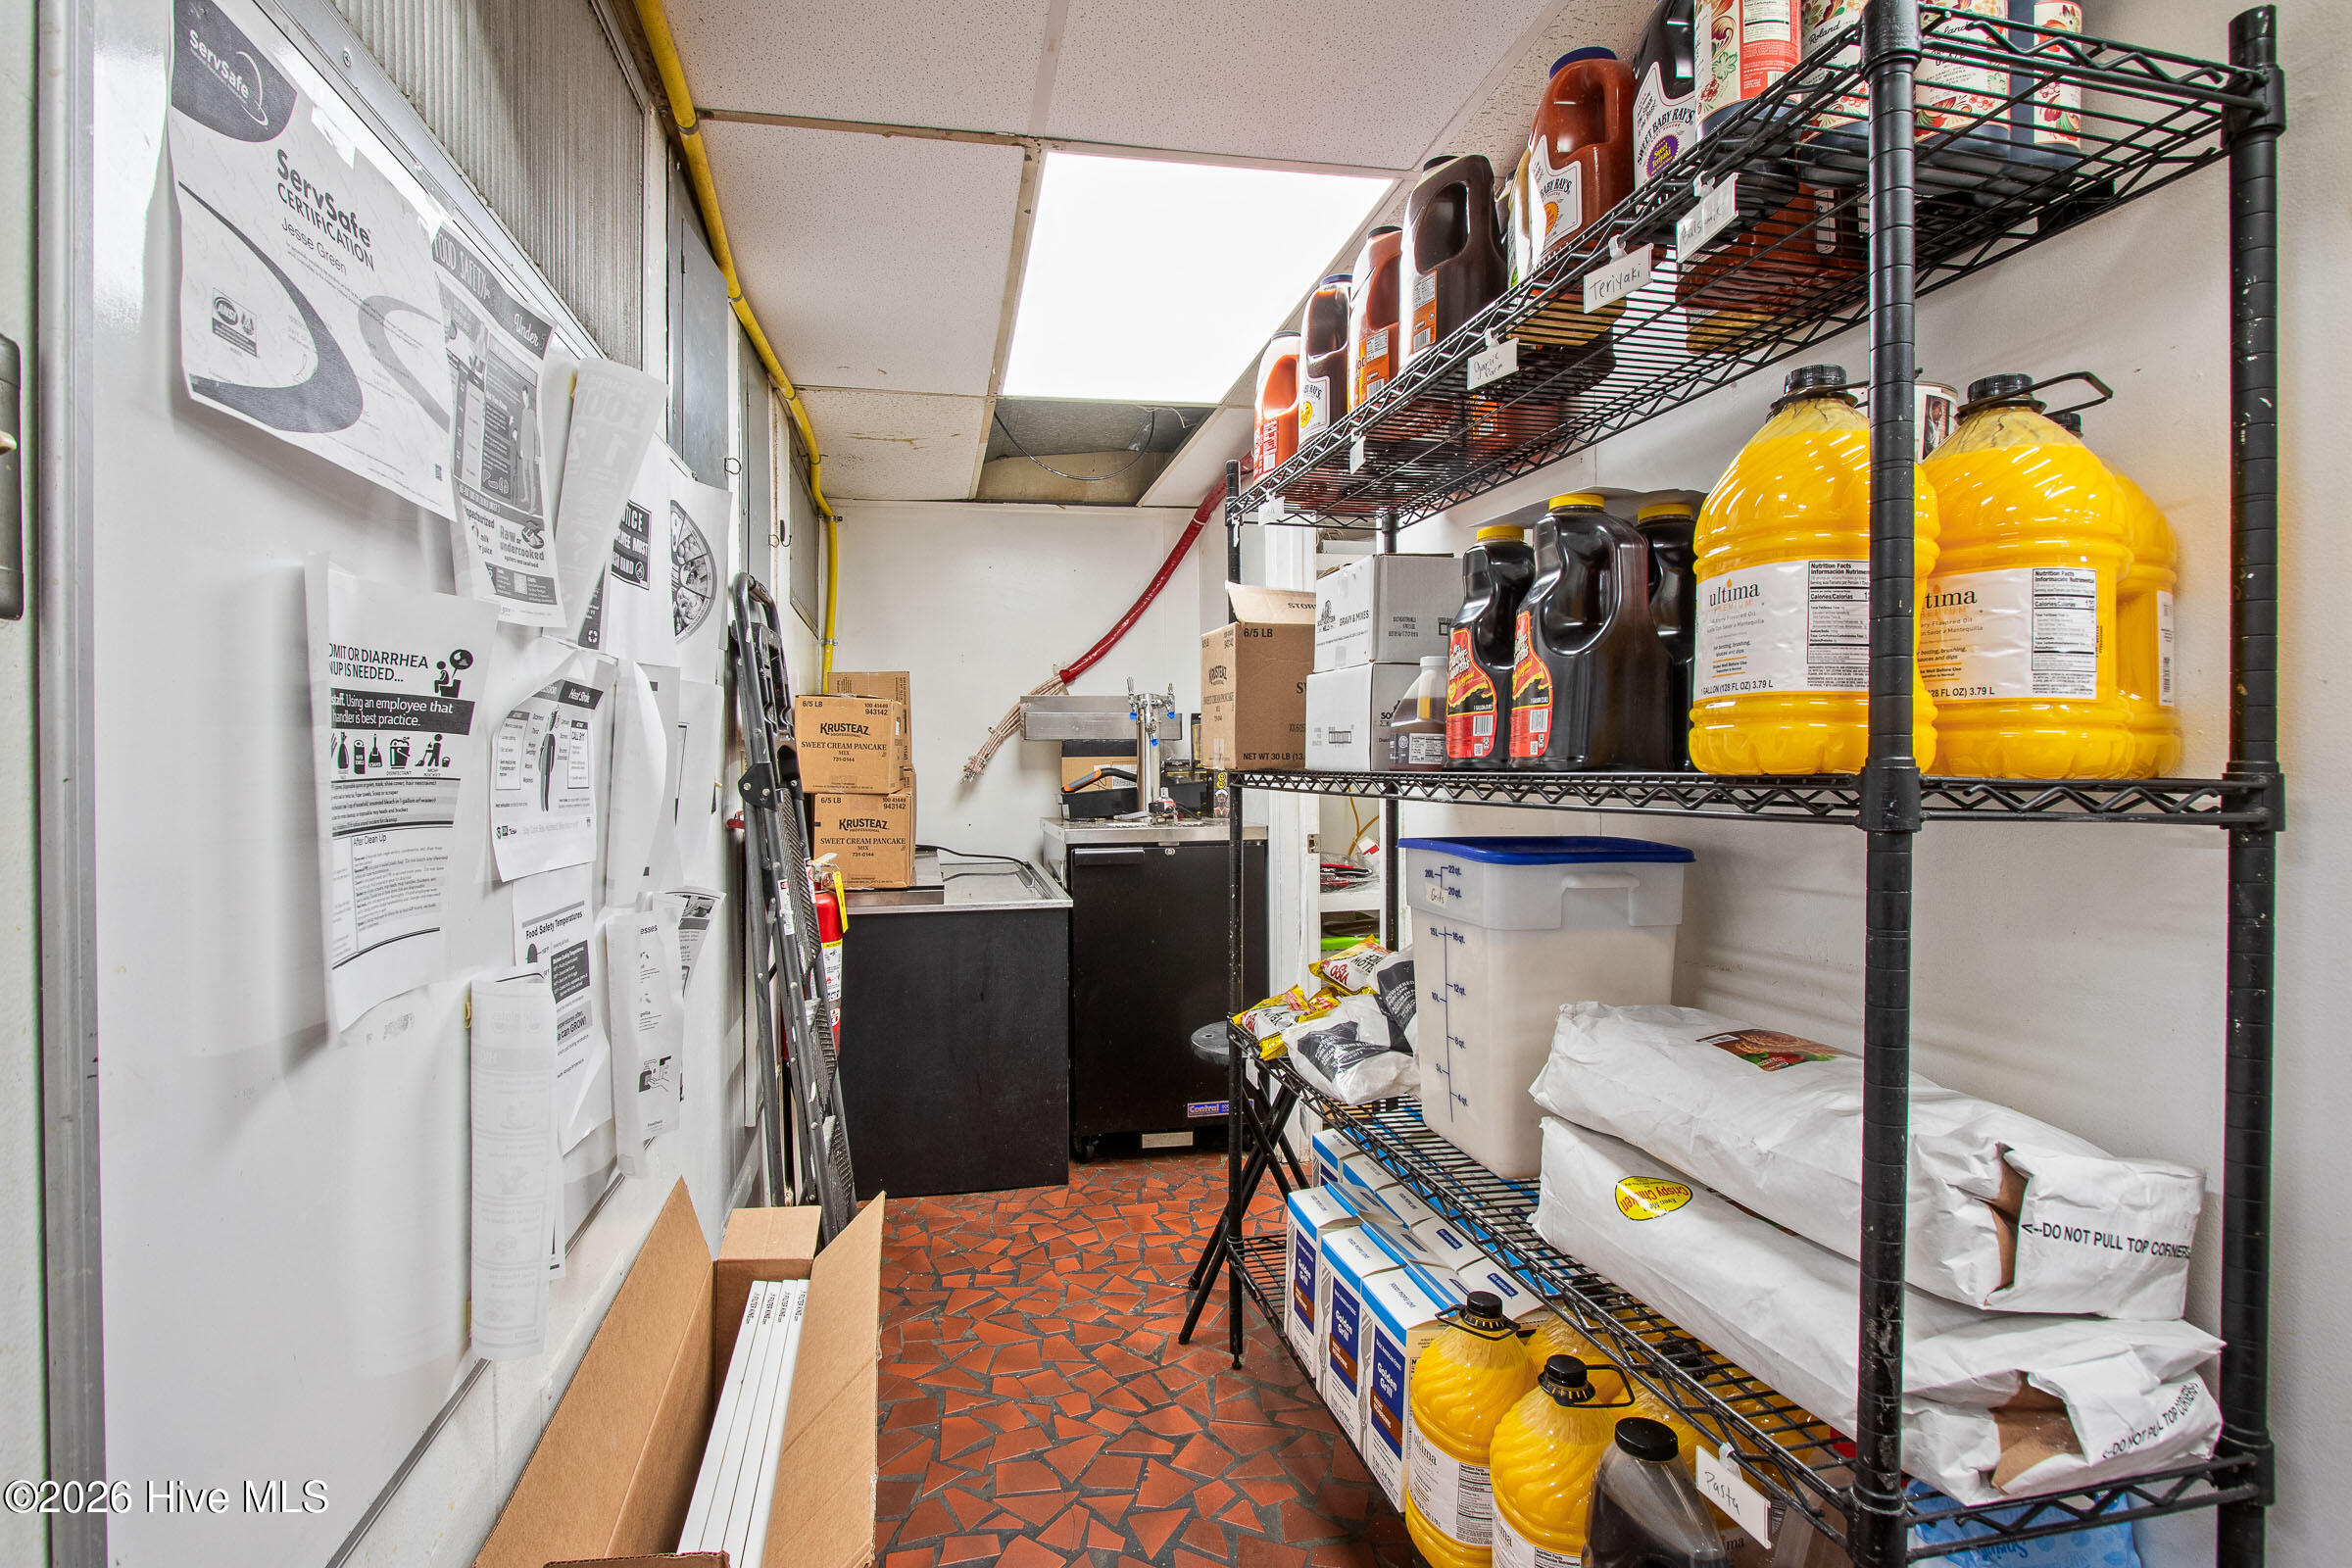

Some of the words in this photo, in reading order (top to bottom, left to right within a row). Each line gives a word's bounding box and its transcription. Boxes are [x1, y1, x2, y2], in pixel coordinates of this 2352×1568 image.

[1808, 21, 1840, 45] Roland
[1943, 22, 1970, 34] land
[189, 28, 249, 99] ServSafe
[1652, 110, 1672, 133] BABY
[1672, 108, 1695, 124] RAY'S
[277, 149, 371, 249] ServSafe
[277, 182, 374, 272] CERTIFICATION
[282, 218, 314, 250] Jesse
[317, 242, 347, 275] Green
[1589, 263, 1642, 301] Teriyaki
[514, 313, 539, 347] Under
[500, 524, 516, 543] Raw
[500, 542, 545, 562] undercooked
[1709, 580, 1760, 607] ultima
[1925, 588, 1978, 609] tima
[1244, 628, 1258, 638] 6/5
[1261, 628, 1273, 638] LB
[347, 646, 360, 662] OR
[361, 649, 428, 669] DIARRHEA
[353, 664, 404, 683] NEEDED...
[1731, 682, 1739, 691] FL
[1740, 681, 1751, 692] OZ)
[1752, 679, 1767, 689] 3.79
[1768, 679, 1774, 688] L
[1940, 688, 1950, 697] FL
[1952, 688, 1968, 698] OZ)
[1969, 687, 1987, 696] 3.79
[1989, 686, 1995, 695] L
[345, 694, 364, 711] Using
[364, 697, 374, 706] an
[375, 697, 427, 714] employee
[429, 701, 454, 714] that
[361, 711, 377, 725] best
[378, 713, 421, 728] practice.
[820, 722, 870, 736] KRUSTEAZ
[1243, 753, 1256, 761] NET
[1258, 753, 1269, 761] WT
[1270, 753, 1280, 761] 30
[1281, 753, 1291, 761] LB
[839, 817, 888, 831] KRUSTEAZ
[378, 833, 387, 843] Up
[525, 928, 539, 940] Food
[539, 920, 555, 937] Safety
[555, 910, 583, 928] Temperatures
[1656, 1185, 1690, 1197] Crispy
[2064, 1226, 2090, 1245] NOT
[2093, 1232, 2123, 1250] PULL
[2127, 1237, 2149, 1253] TOP
[1298, 1258, 1311, 1281] Golden
[1299, 1270, 1308, 1287] Grill
[1335, 1309, 1353, 1336] Golden
[1338, 1324, 1349, 1343] Grill
[1377, 1361, 1397, 1393] Golden
[1379, 1377, 1393, 1399] Grill
[2162, 1406, 2178, 1427] TOP
[1704, 1471, 1740, 1516] Pasta
